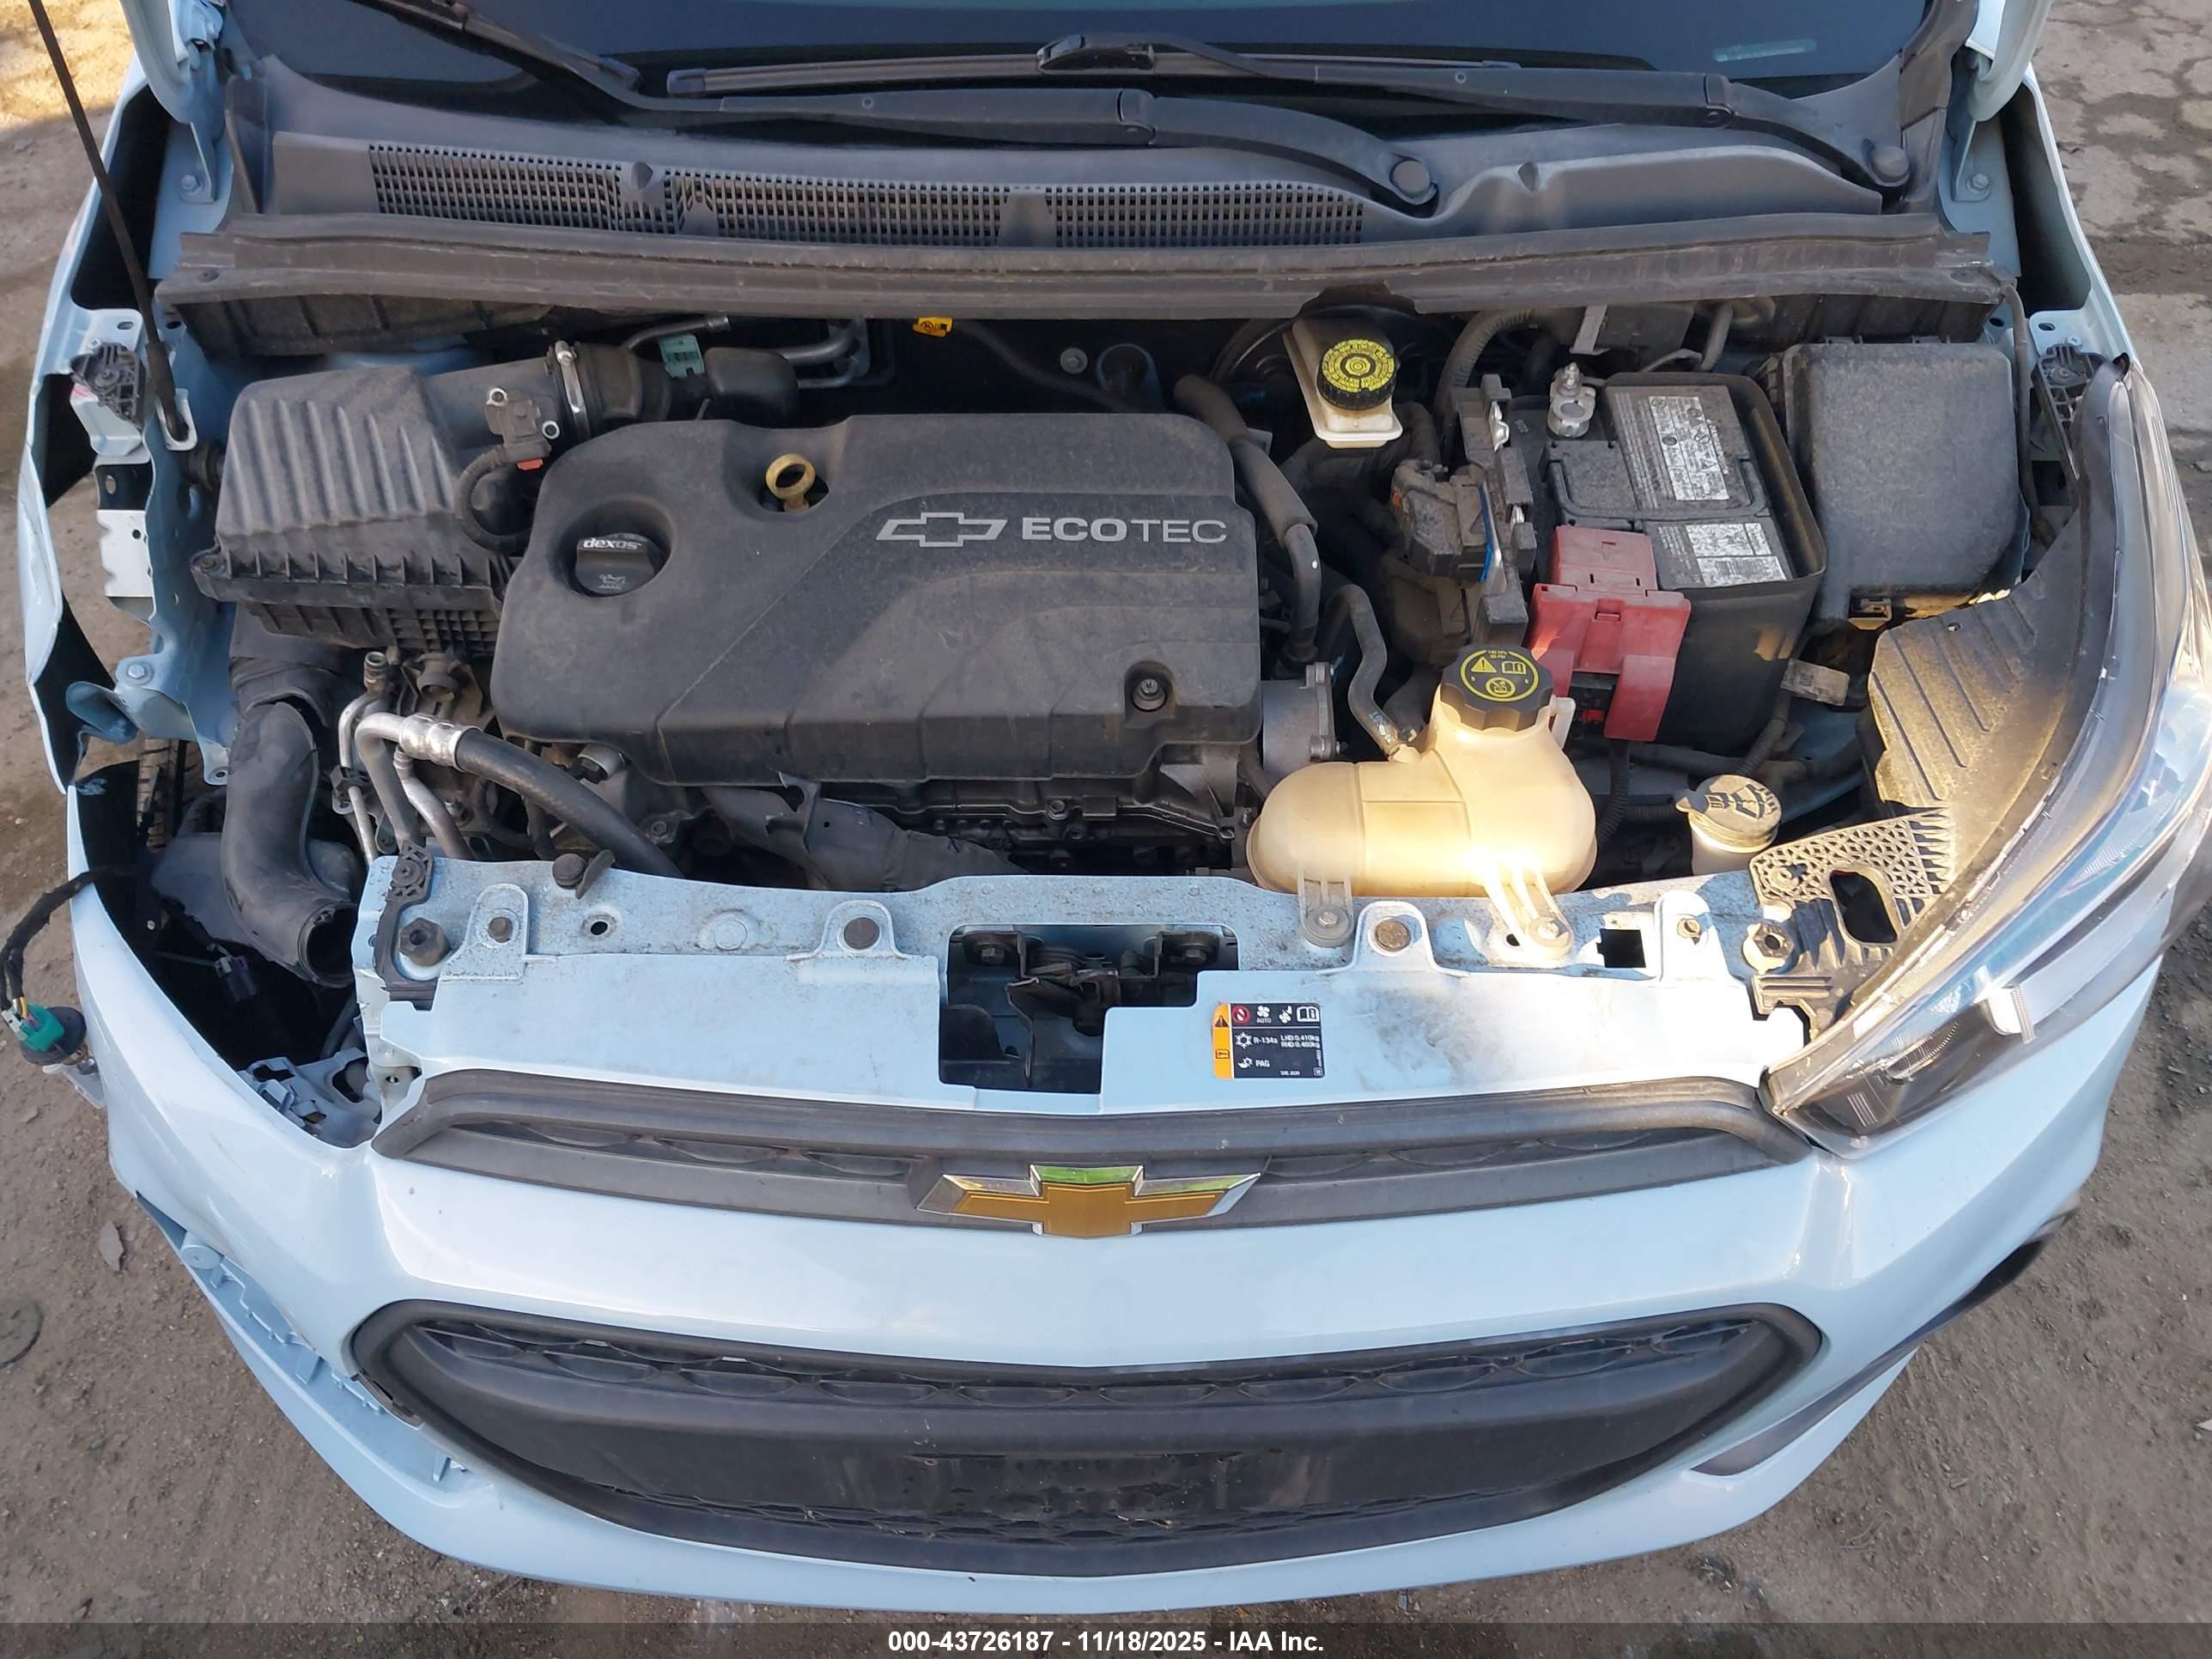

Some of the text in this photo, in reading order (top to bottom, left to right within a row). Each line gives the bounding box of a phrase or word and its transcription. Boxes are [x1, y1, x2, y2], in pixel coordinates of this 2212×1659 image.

[1022, 517, 1227, 544] ECOTEC
[583, 538, 640, 550] dexos
[1255, 1059, 1271, 1067] PAG
